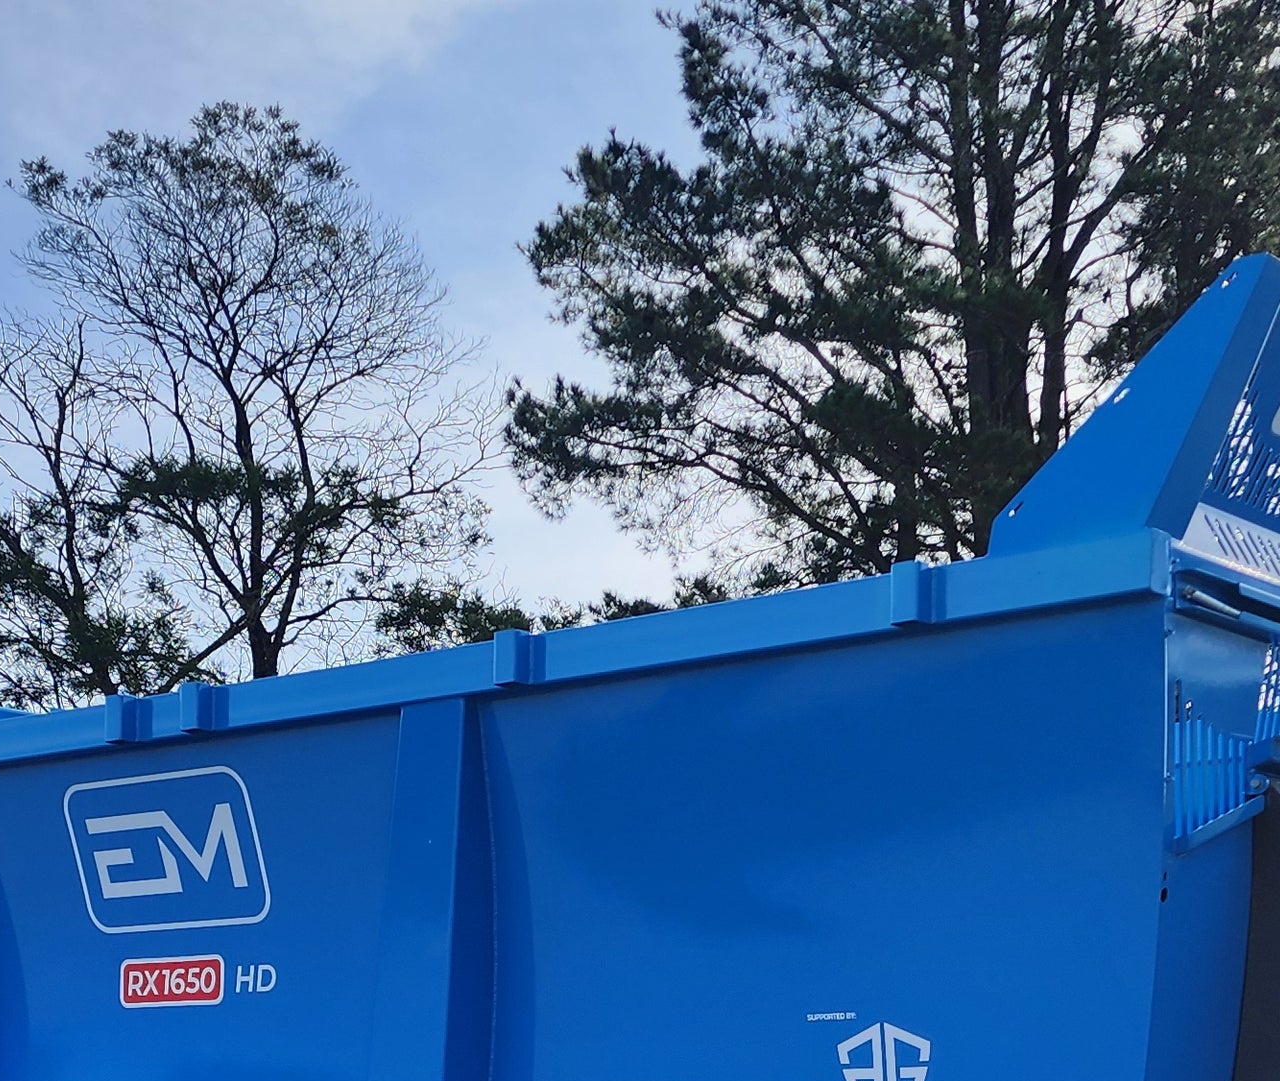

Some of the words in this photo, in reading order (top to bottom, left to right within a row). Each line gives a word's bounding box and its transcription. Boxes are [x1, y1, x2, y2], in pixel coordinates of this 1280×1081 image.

[85, 802, 248, 899] EM
[127, 966, 217, 997] RX1650
[235, 964, 277, 994] HD
[806, 1012, 846, 1022] SUPPORTED
